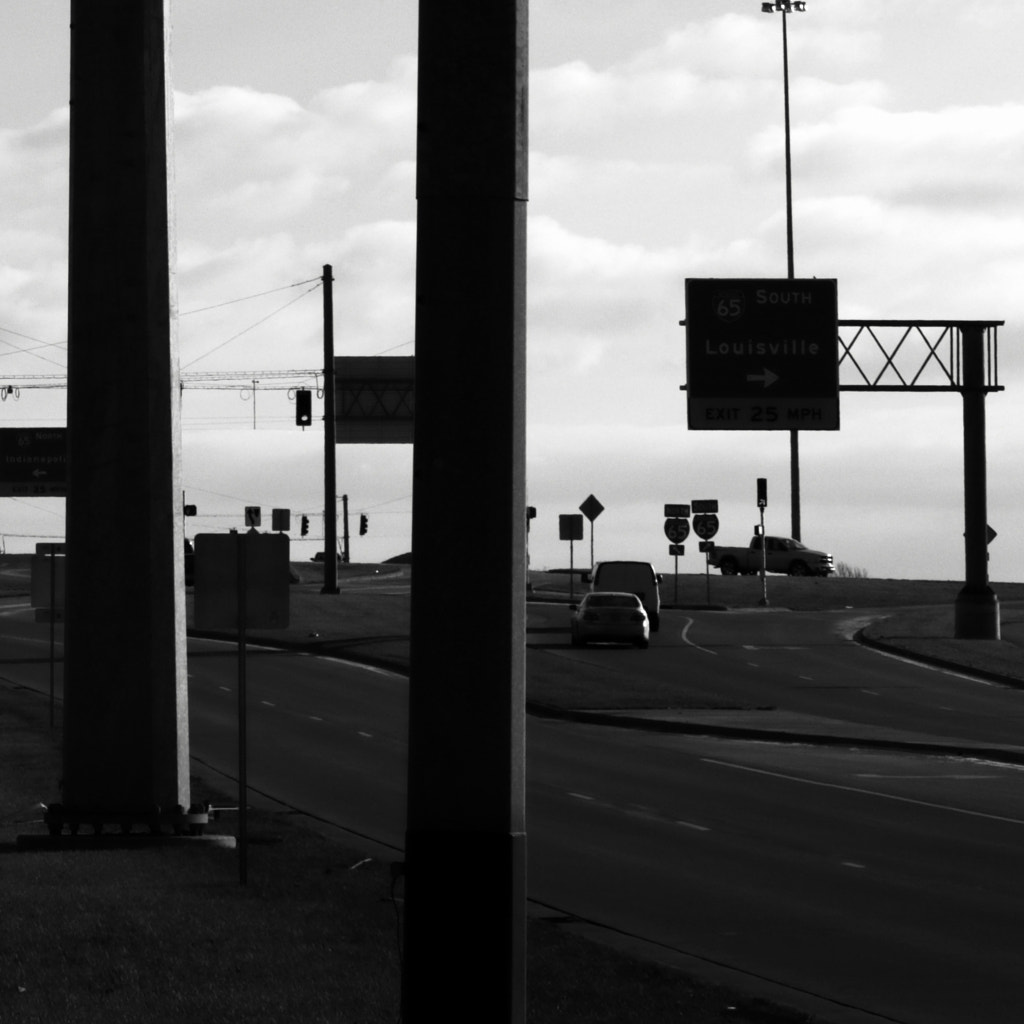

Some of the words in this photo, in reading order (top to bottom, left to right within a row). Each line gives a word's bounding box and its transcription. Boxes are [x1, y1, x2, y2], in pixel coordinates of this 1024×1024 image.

[716, 298, 742, 317] 65
[755, 289, 812, 305] SOUTH
[705, 338, 820, 356] Louisville
[705, 408, 741, 420] EXIT
[750, 406, 779, 423] 25
[787, 408, 822, 420] MPH
[6, 455, 66, 465] Indianapoli
[668, 525, 688, 540] 65
[696, 520, 716, 536] 65
